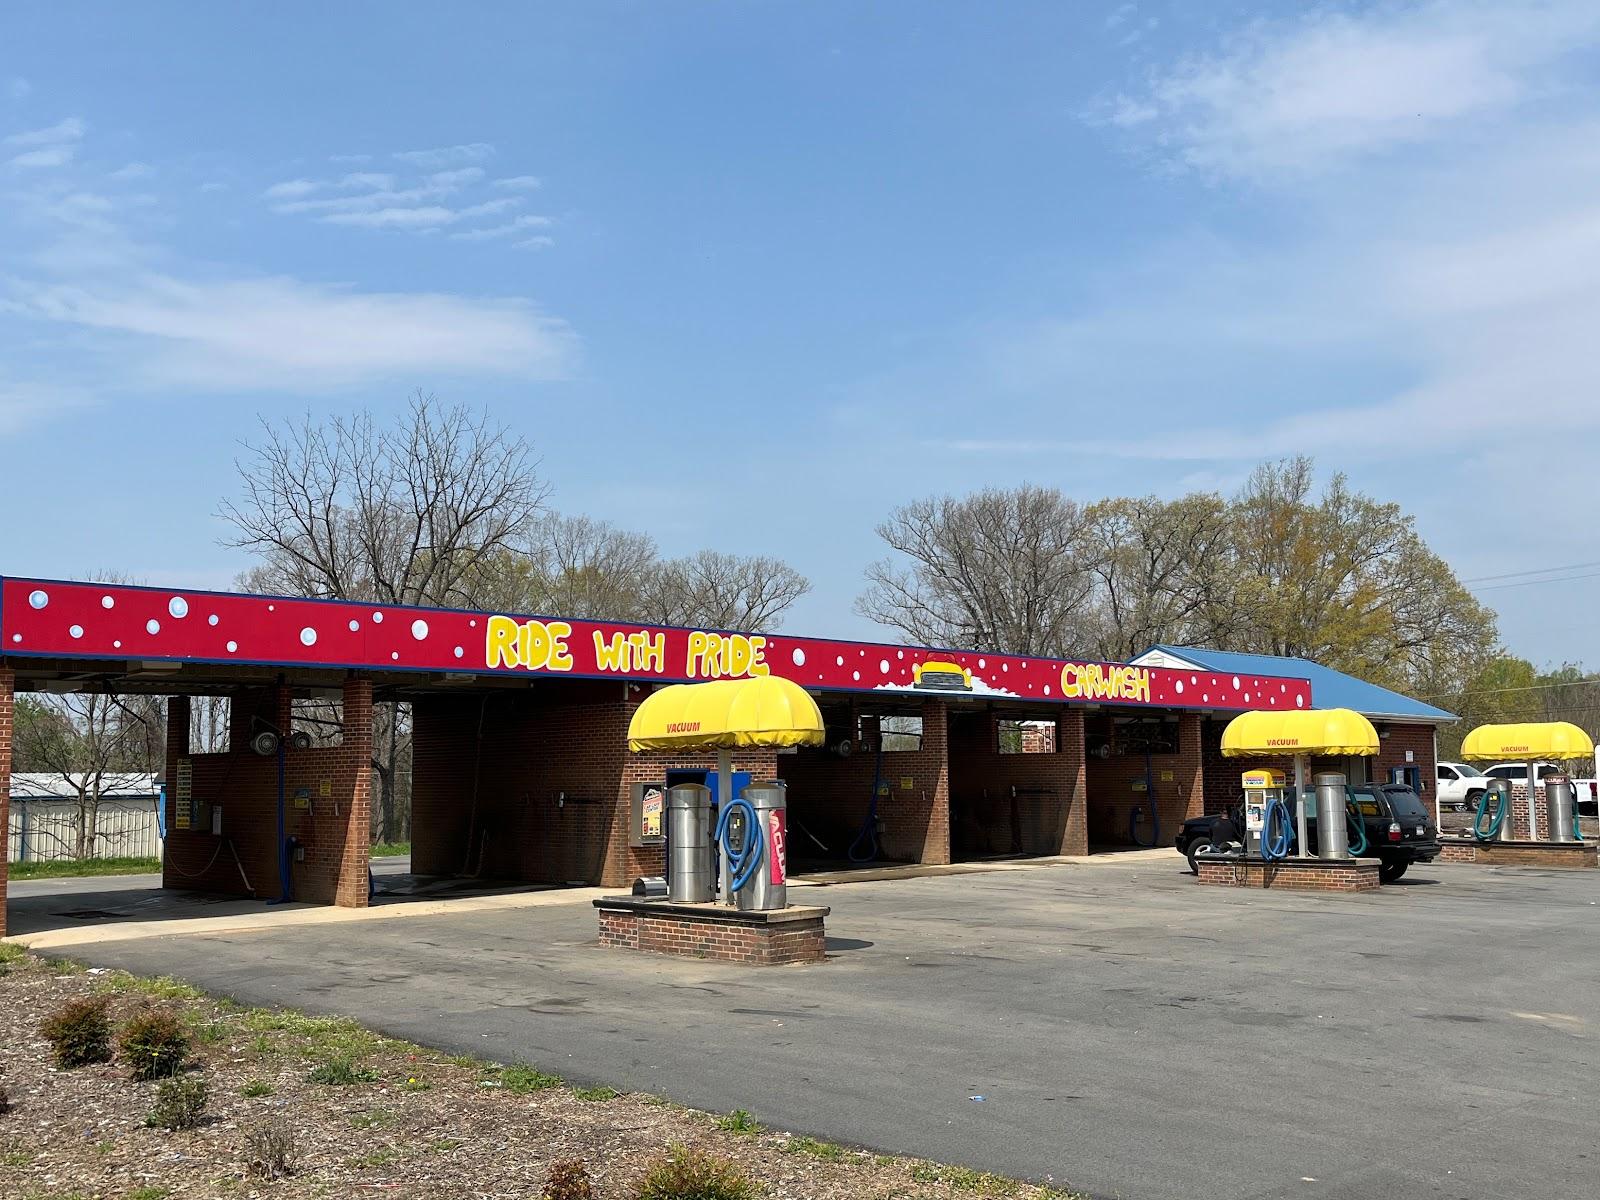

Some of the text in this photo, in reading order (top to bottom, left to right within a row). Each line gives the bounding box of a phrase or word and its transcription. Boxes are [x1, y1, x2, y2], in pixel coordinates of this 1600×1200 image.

[486, 615, 770, 678] RIDE WITH PRIDE
[1061, 663, 1150, 703] CARWASH
[666, 722, 701, 734] VACUUM
[1266, 738, 1299, 746] VACUUM
[1500, 745, 1529, 753] VACUUM
